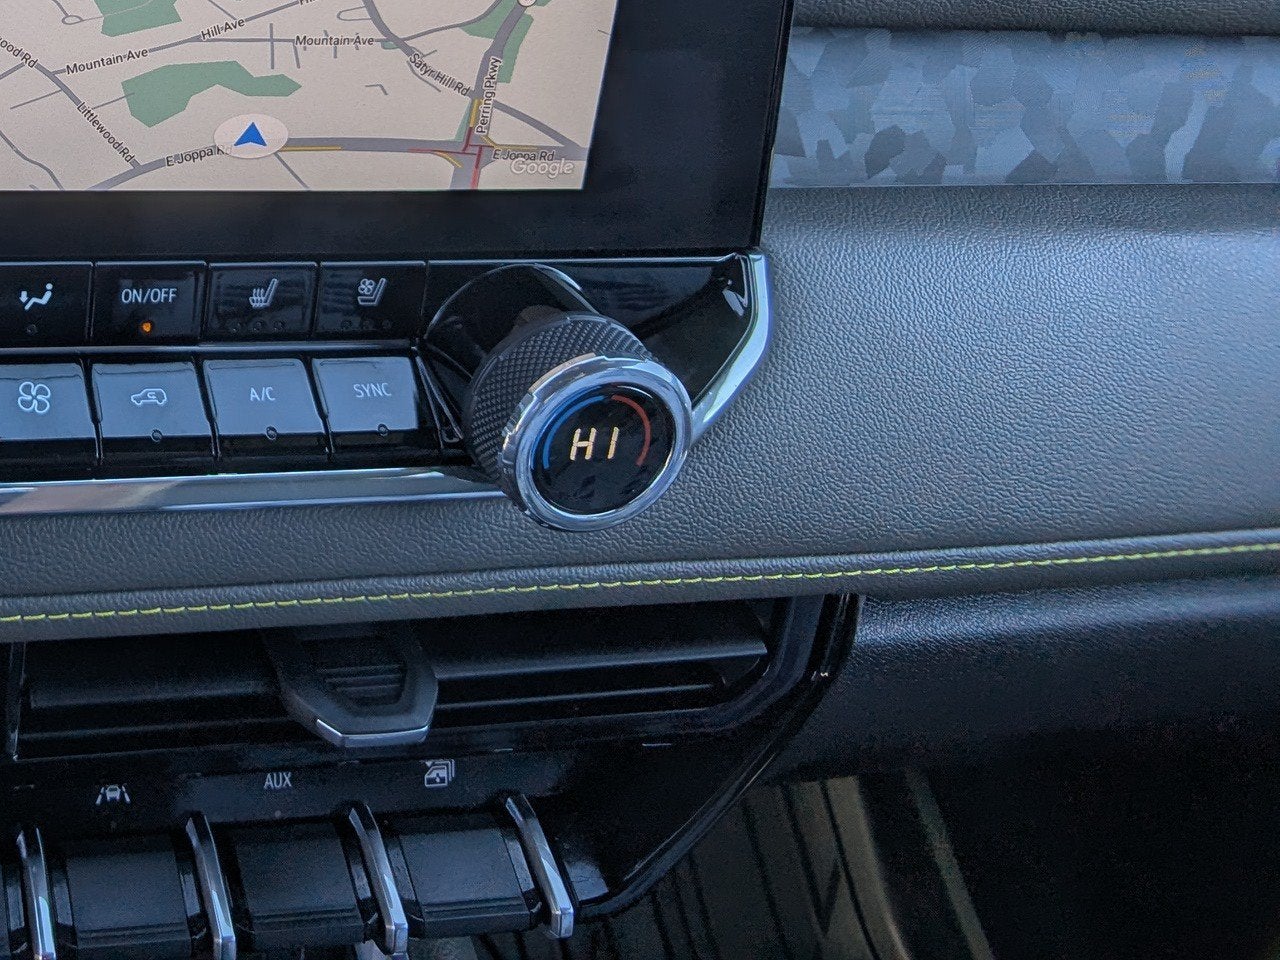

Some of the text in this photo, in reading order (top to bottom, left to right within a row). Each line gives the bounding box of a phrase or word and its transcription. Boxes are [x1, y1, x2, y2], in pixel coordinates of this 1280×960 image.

[201, 18, 245, 40] Hill Ave
[295, 35, 374, 46] Mountain Ave
[20, 51, 38, 68] Rd
[66, 47, 149, 75] Mountain Ave
[409, 53, 471, 96] Satyr Hill Rd
[476, 56, 502, 134] Perring Pkwy
[76, 101, 135, 163] Littlewood Rd
[166, 156, 175, 167] E
[176, 147, 214, 165] Joppa
[492, 149, 501, 159] E
[539, 150, 556, 161] Rd
[510, 158, 574, 179] Google
[121, 287, 177, 304] ON/OFF
[249, 386, 276, 402] A/C
[353, 382, 392, 399] SYNC
[264, 771, 292, 790] AUX
